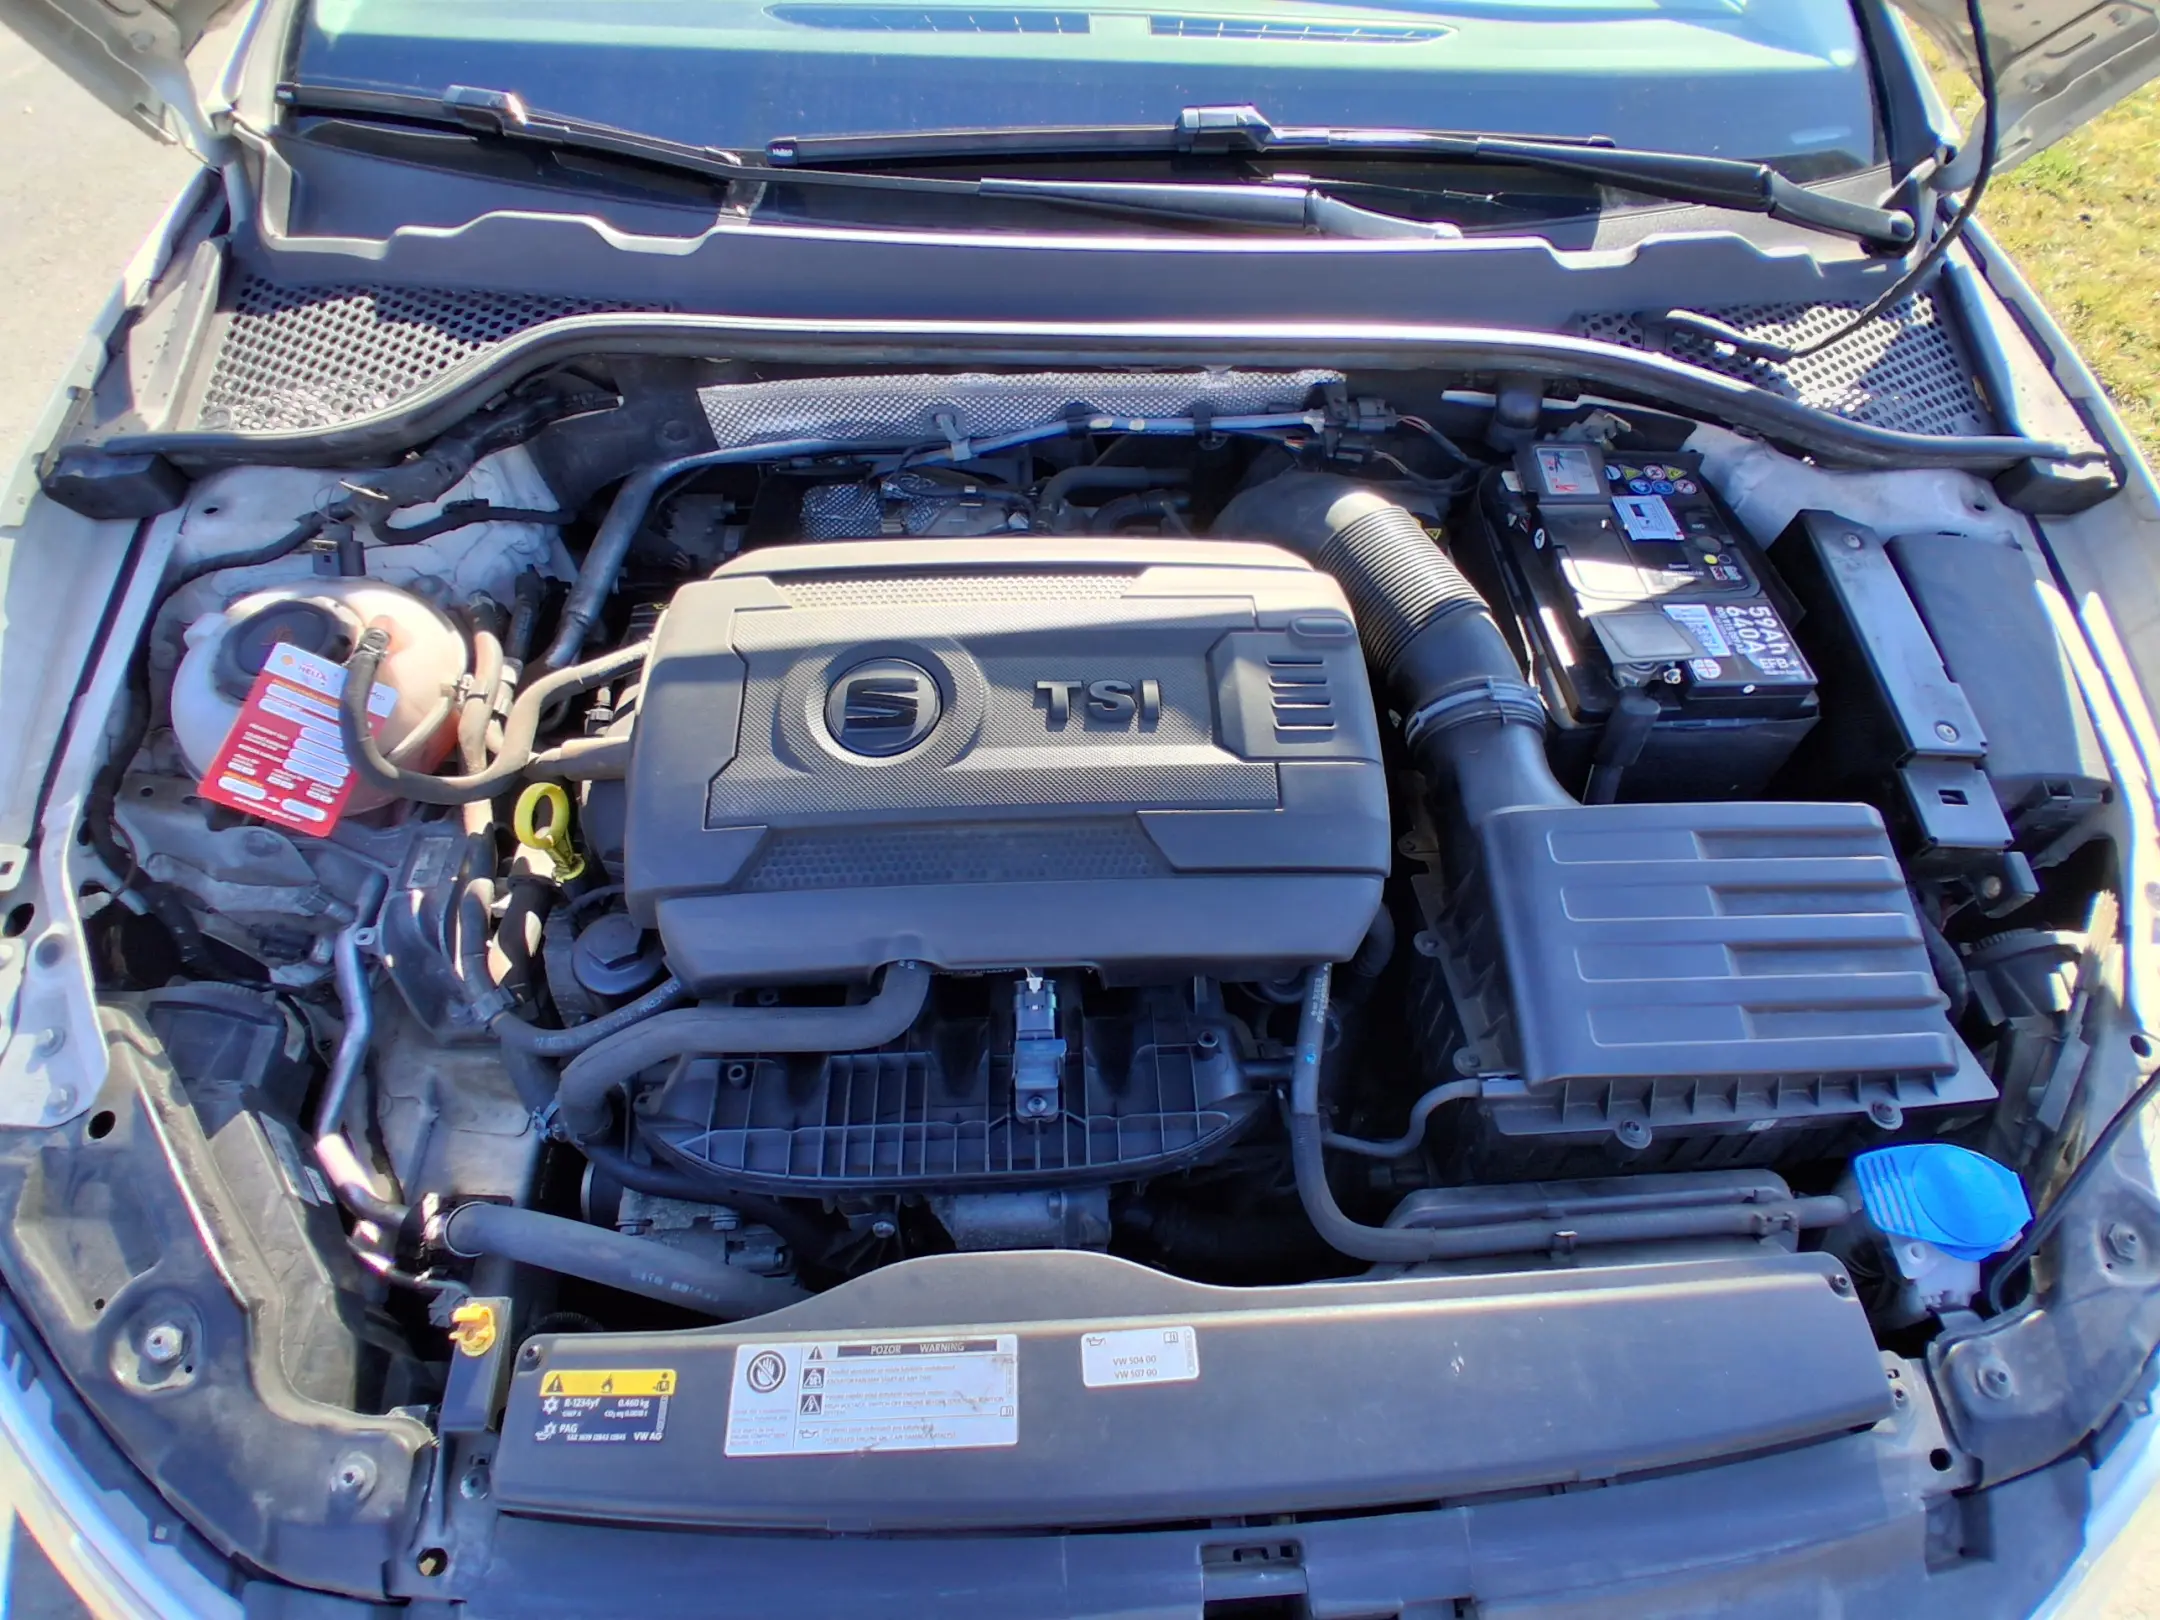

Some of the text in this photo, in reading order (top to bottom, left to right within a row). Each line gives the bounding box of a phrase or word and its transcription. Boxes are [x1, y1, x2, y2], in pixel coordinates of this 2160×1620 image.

[1726, 606, 1767, 653] 640A
[1749, 606, 1791, 655] 59Ah
[1035, 679, 1162, 721] TSI
[870, 1342, 965, 1355] POZOR WARNING
[1113, 1355, 1157, 1366] VW 504 00
[1114, 1368, 1158, 1379] VW 507 00
[563, 1397, 600, 1410] R-1234yf
[640, 1399, 650, 1409] kg
[559, 1423, 579, 1433] PAG
[633, 1432, 662, 1441] VW AG
